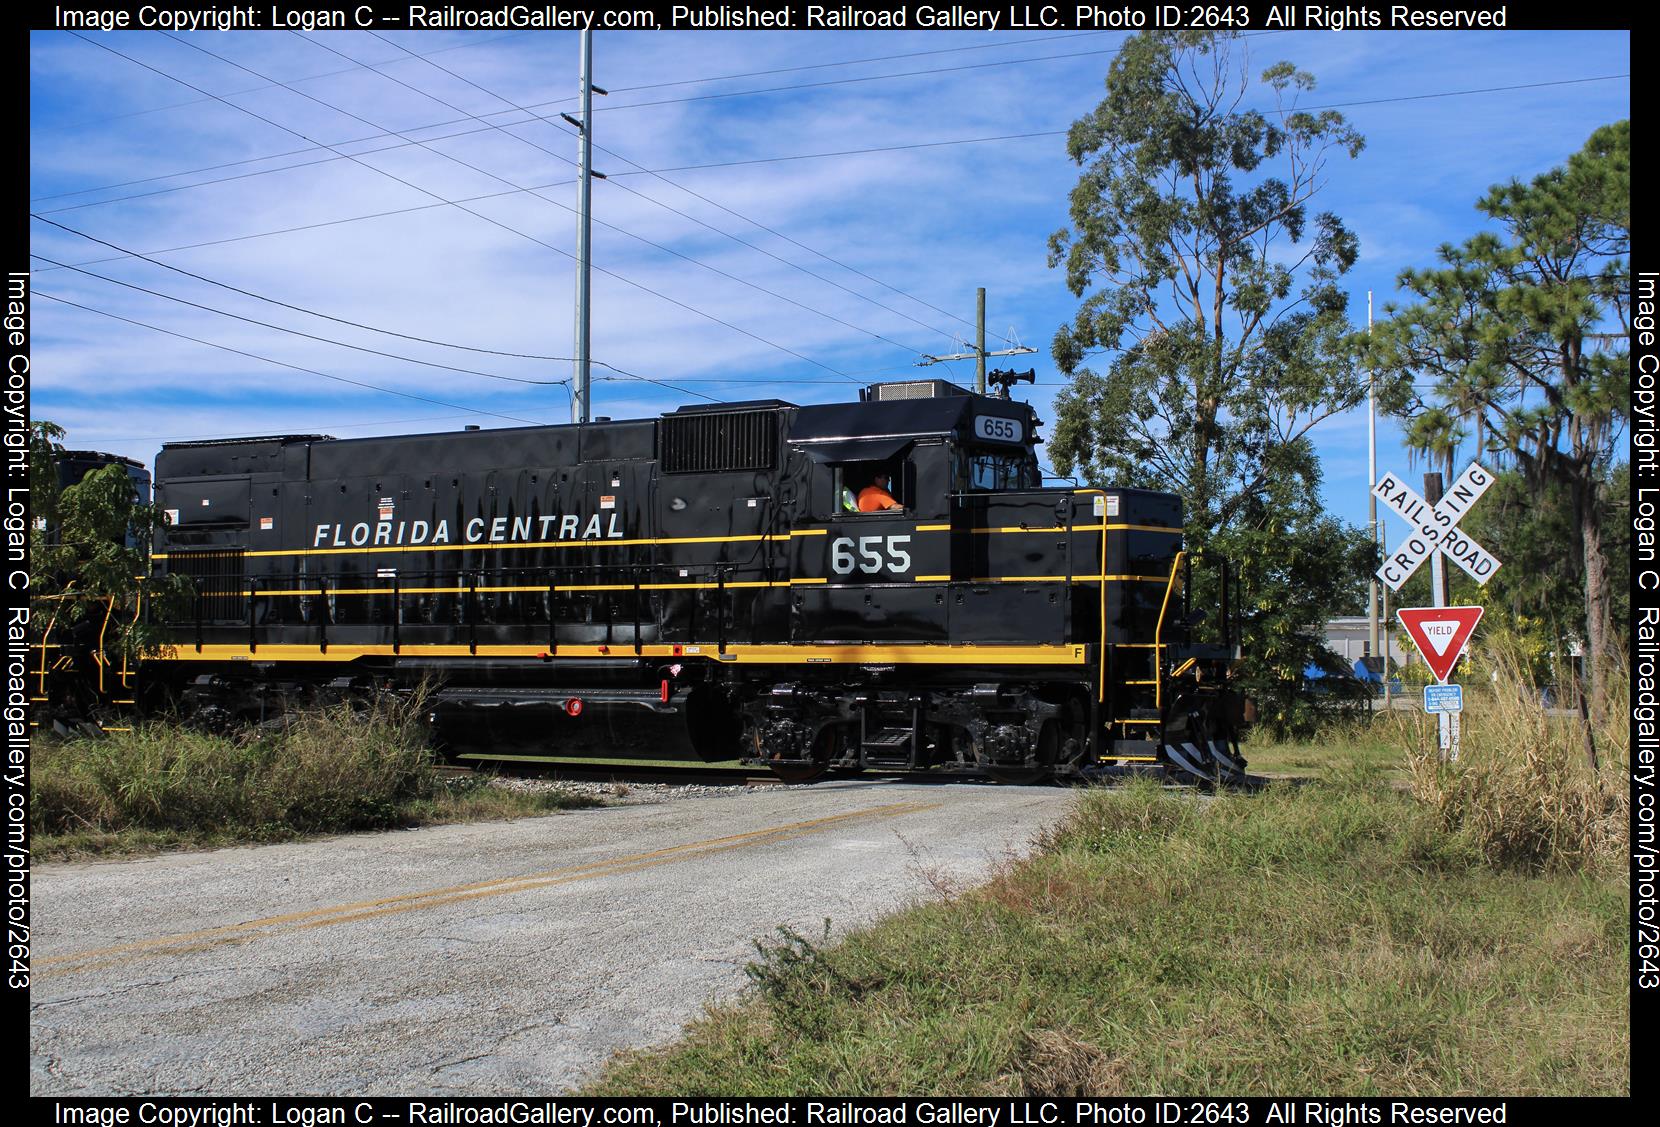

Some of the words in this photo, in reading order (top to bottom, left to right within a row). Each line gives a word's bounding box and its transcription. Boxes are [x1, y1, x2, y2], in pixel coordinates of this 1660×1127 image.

[984, 419, 1013, 438] 655
[313, 520, 449, 547] FLORIDA
[466, 513, 624, 542] CENTRAL
[1384, 470, 1486, 582] CROSSING
[832, 535, 911, 574] 655
[1428, 626, 1452, 635] YIELD
[1075, 647, 1083, 658] F
